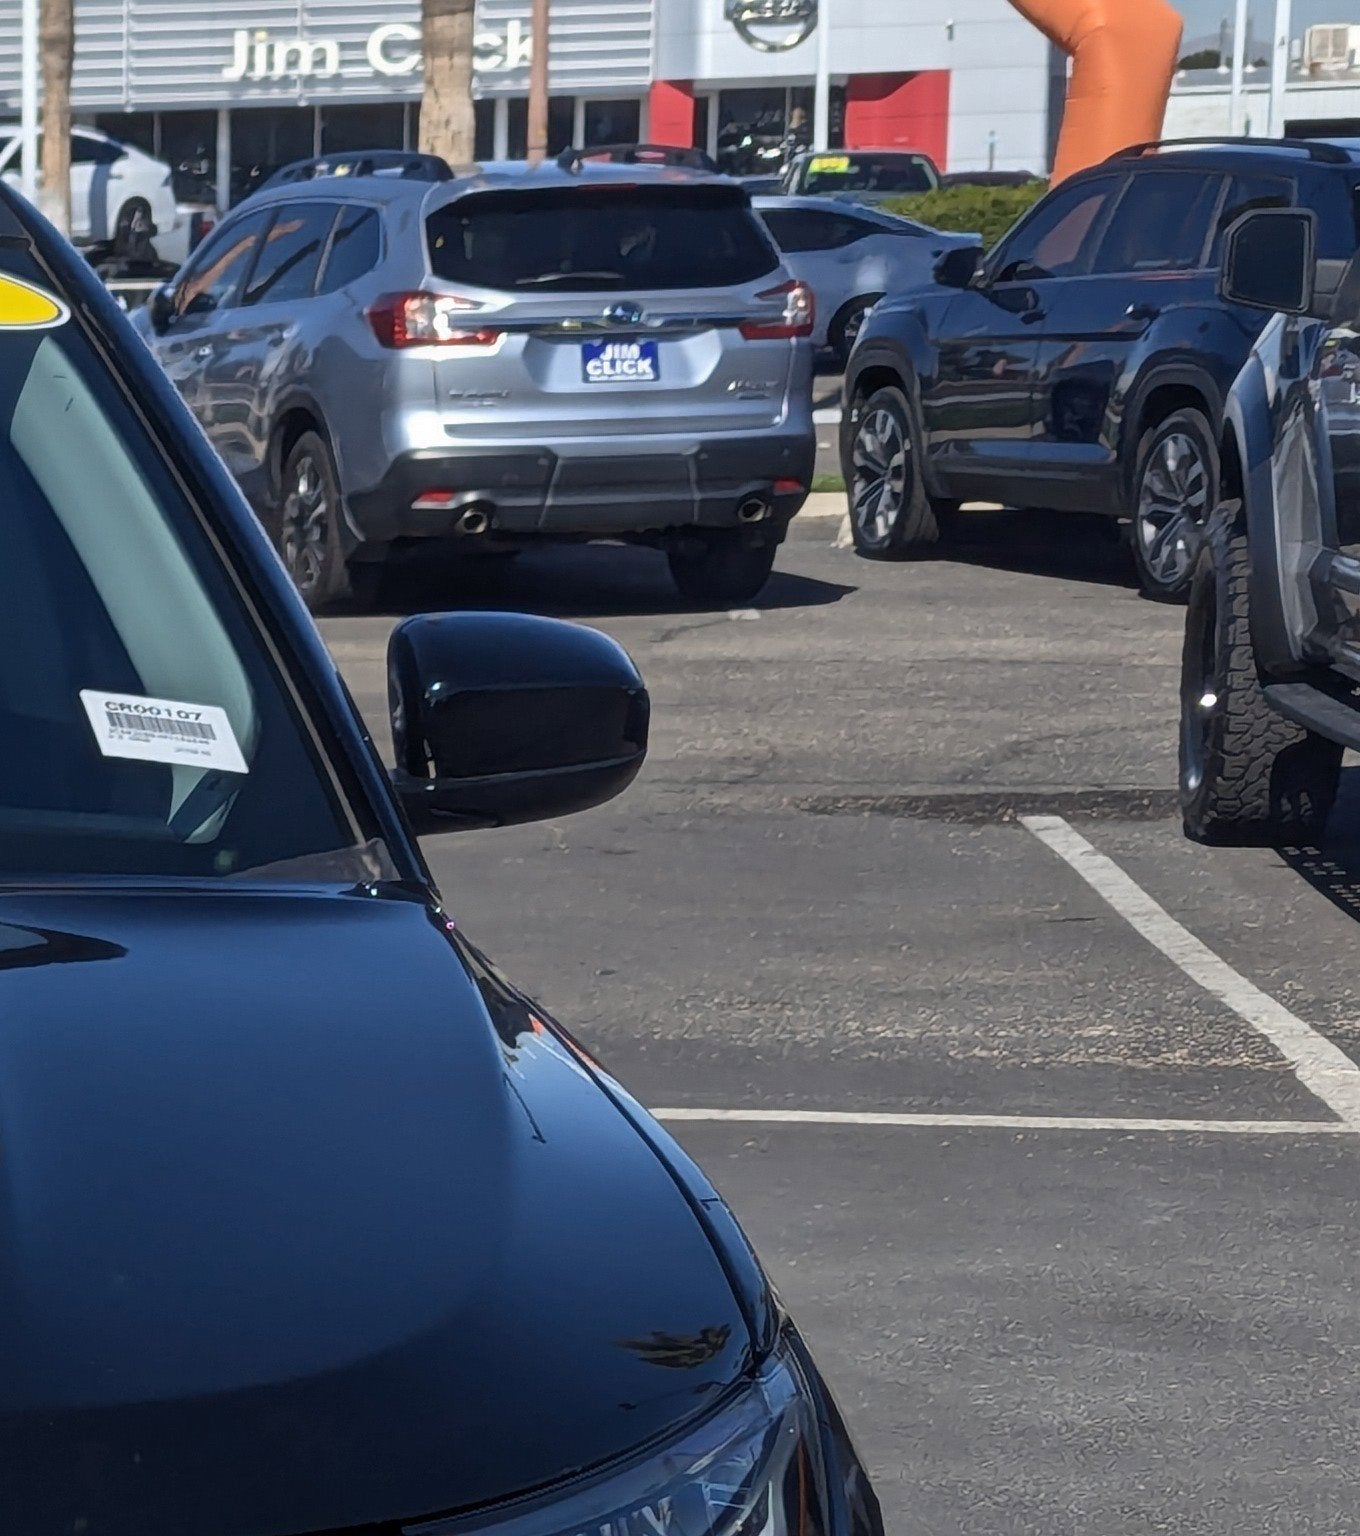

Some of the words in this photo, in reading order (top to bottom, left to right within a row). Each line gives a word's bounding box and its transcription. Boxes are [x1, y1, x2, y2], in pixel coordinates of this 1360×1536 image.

[222, 29, 340, 80] Jim
[366, 19, 534, 76] Cck
[599, 342, 641, 360] JIM
[586, 358, 654, 375] CLICK
[105, 700, 203, 722] CR00107
